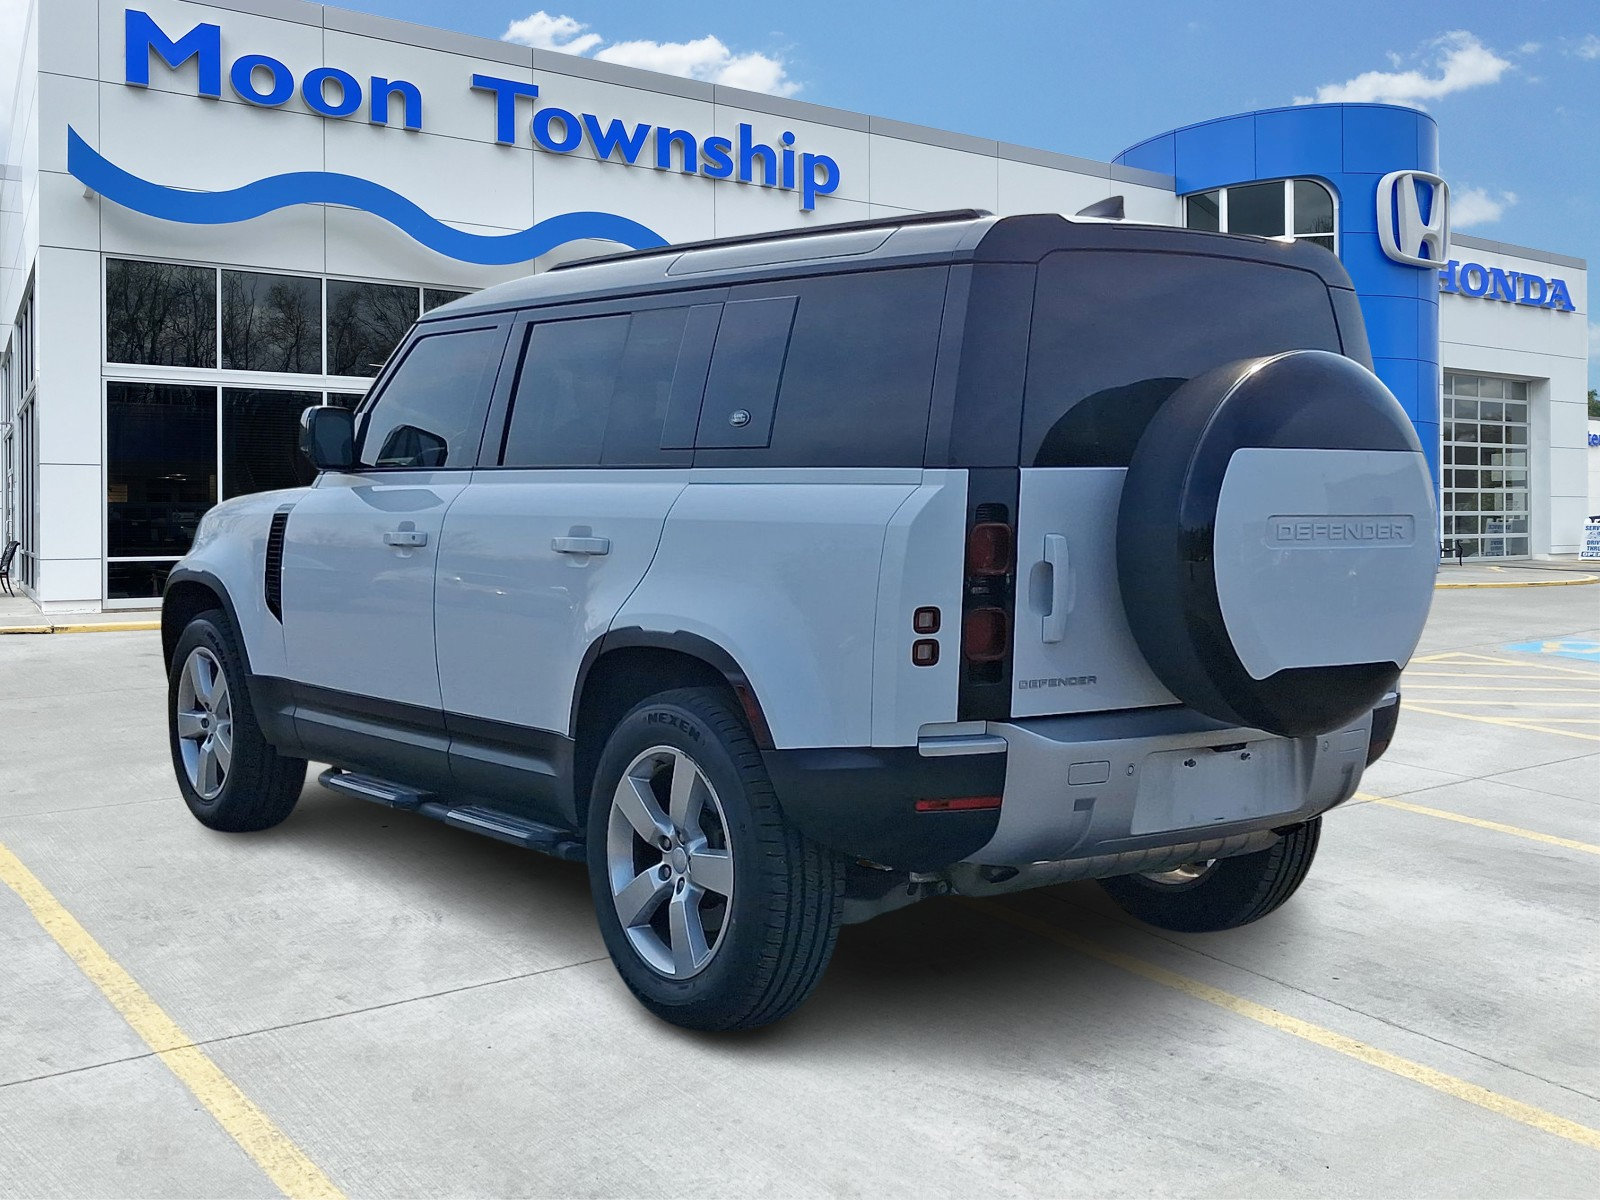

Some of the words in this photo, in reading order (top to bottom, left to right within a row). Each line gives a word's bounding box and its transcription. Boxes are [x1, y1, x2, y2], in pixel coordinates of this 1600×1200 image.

[125, 9, 422, 131] Moon
[470, 74, 841, 212] Township
[1438, 259, 1576, 312] HONDA
[1588, 430, 1600, 447] te
[1276, 523, 1406, 541] DEFENDER
[1018, 676, 1097, 690] DEFENDER
[647, 712, 701, 742] NEXEN
